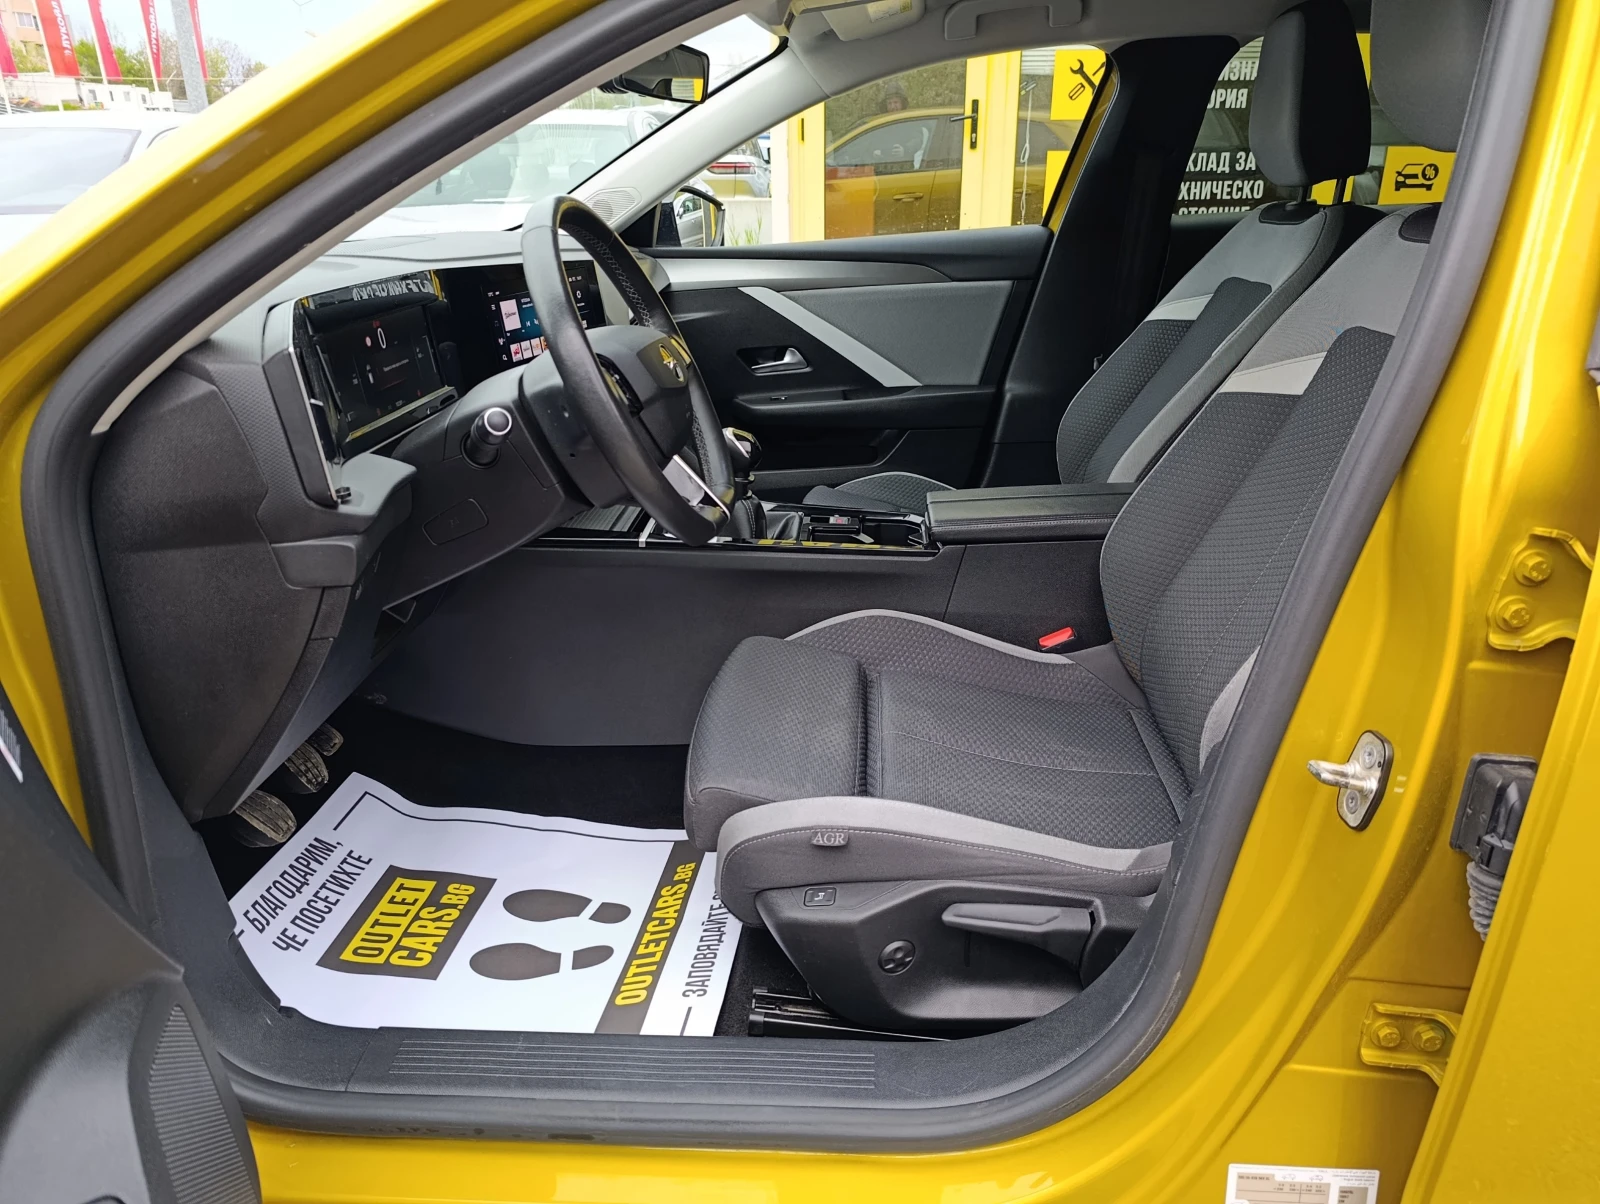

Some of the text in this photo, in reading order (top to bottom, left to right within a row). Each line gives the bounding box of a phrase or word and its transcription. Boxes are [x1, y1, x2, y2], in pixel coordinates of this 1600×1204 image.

[1178, 180, 1264, 200] ХНИЧЕСКО
[1235, 151, 1256, 171] ЗА
[812, 832, 845, 845] AGR
[243, 837, 343, 934] БЛАГОДАРИМ,
[272, 849, 373, 952] ЧЕ ПОСЕТИХТЕ
[352, 883, 428, 958] OUTLET
[389, 883, 475, 968] CARS.BG
[614, 862, 696, 1006] OUTLETCARS.BG
[682, 903, 729, 998] ЗАПОВЯДАЙТЕ
